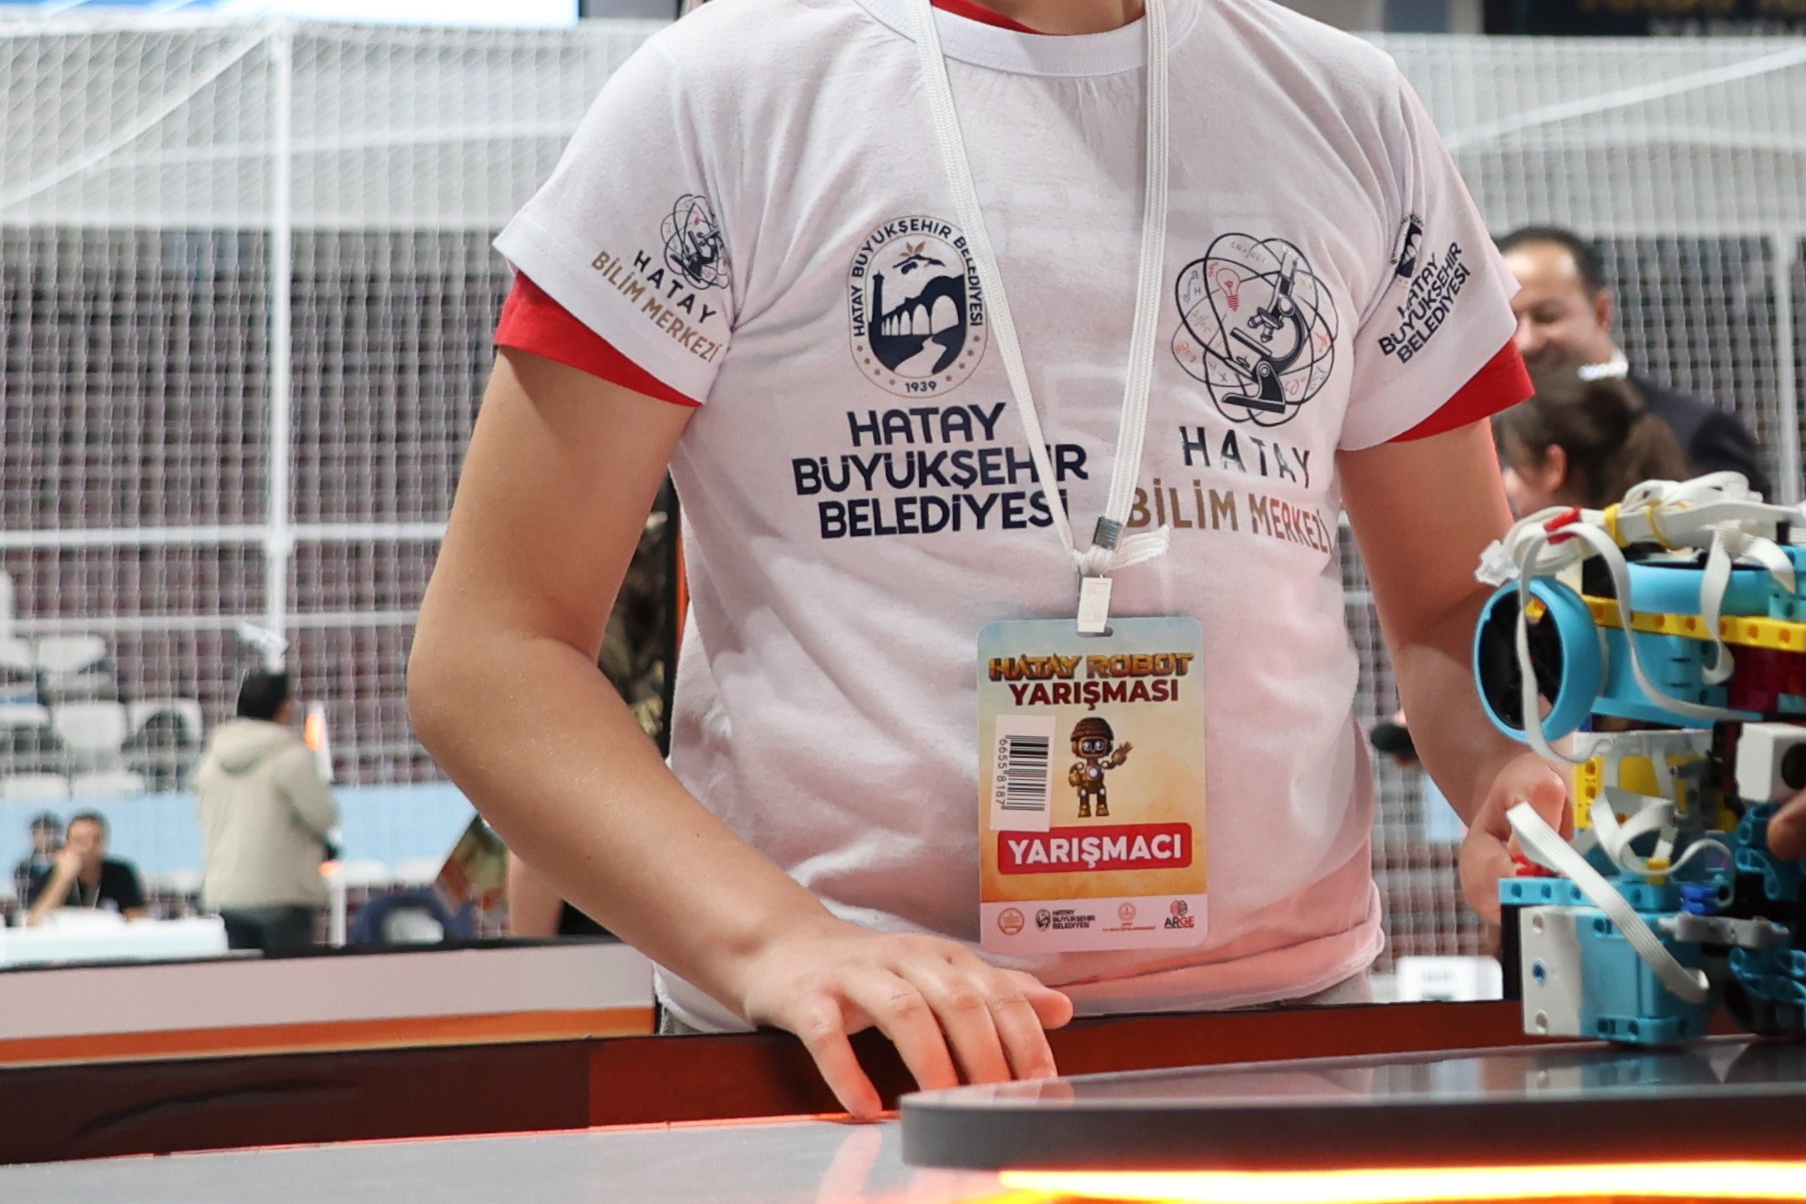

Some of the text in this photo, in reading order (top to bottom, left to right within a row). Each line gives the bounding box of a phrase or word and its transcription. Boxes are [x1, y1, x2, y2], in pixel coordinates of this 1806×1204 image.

[591, 251, 724, 363] BİLİM MERKEZİ
[633, 250, 717, 324] HATAY
[851, 286, 866, 337] HATAY
[905, 381, 937, 394] 1939
[847, 402, 1006, 447] HATAY
[1178, 425, 1311, 489] HATAY
[1126, 477, 1333, 555] BİLİM MERKEZİ
[988, 652, 1195, 682] HATAY ROBOT
[1009, 679, 1179, 711] YARIŞMASI
[1008, 833, 1182, 869] YARIŞMACI
